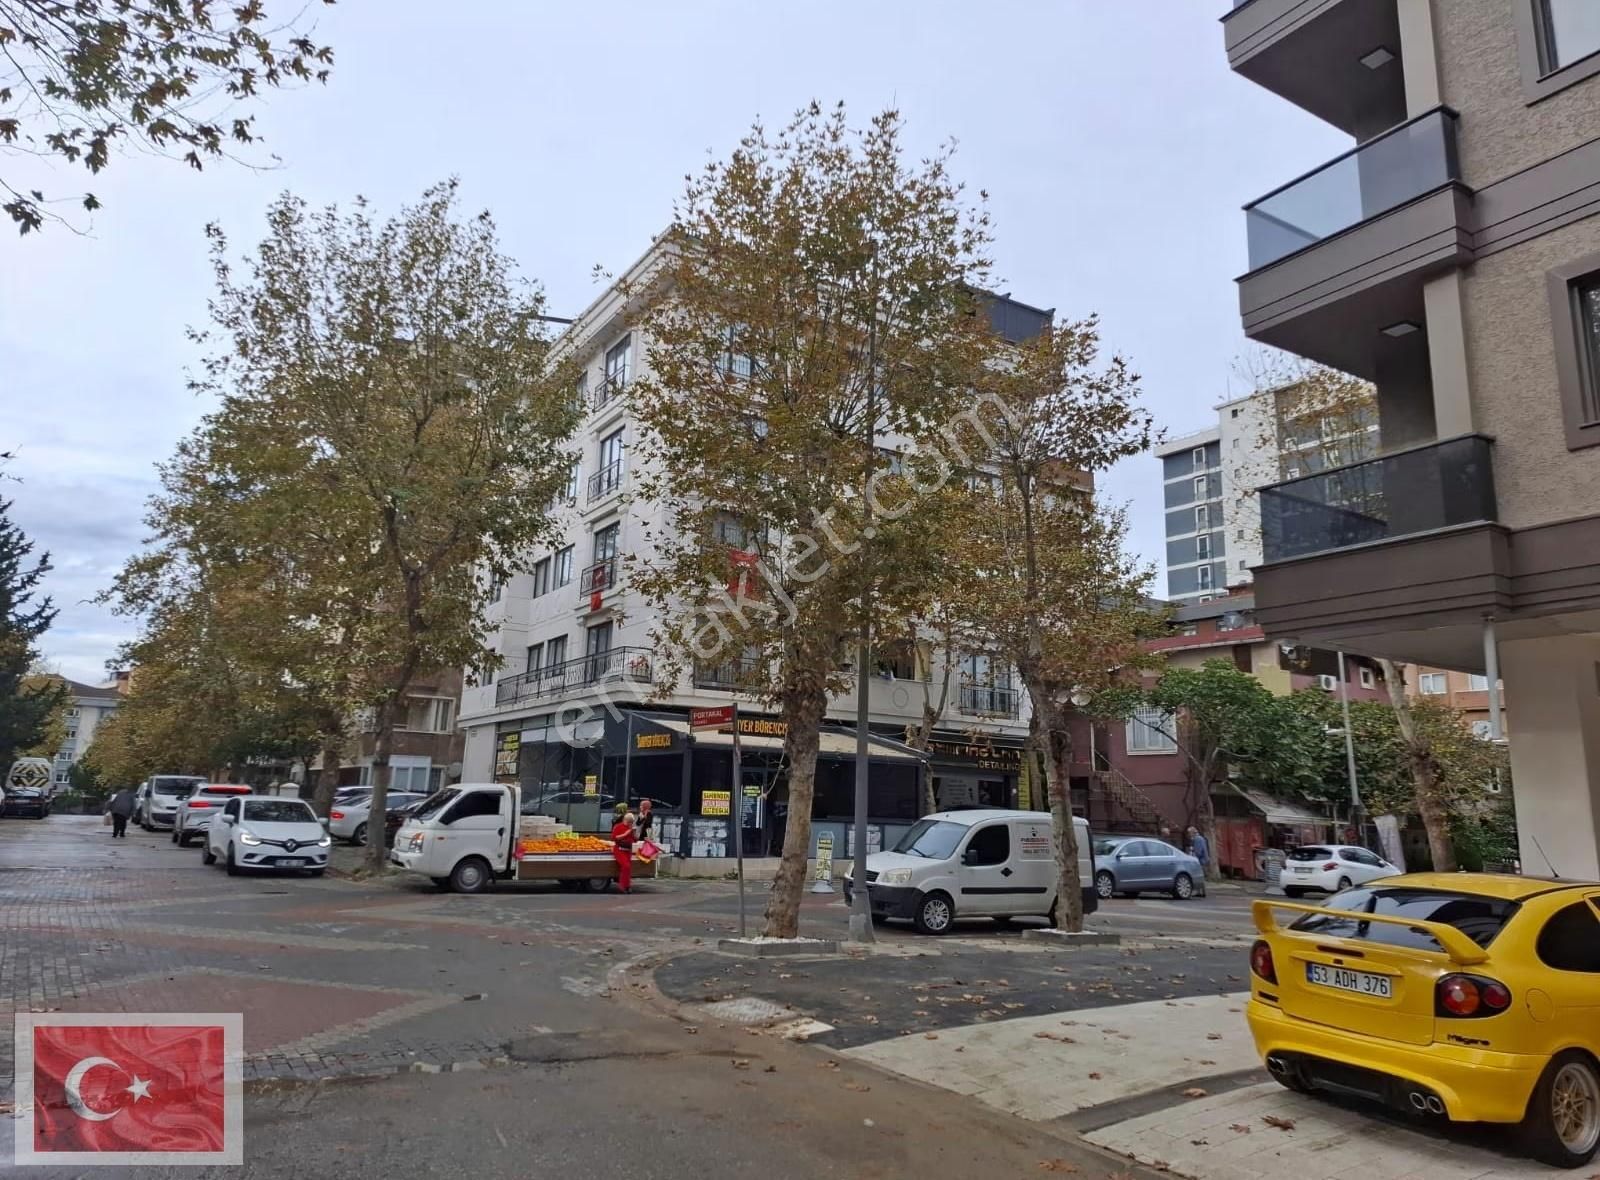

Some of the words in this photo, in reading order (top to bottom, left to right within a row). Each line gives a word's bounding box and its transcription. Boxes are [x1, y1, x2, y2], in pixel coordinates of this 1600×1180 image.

[1313, 965, 1328, 983] 53
[1335, 970, 1357, 989] ADH
[1363, 975, 1388, 995] 376
